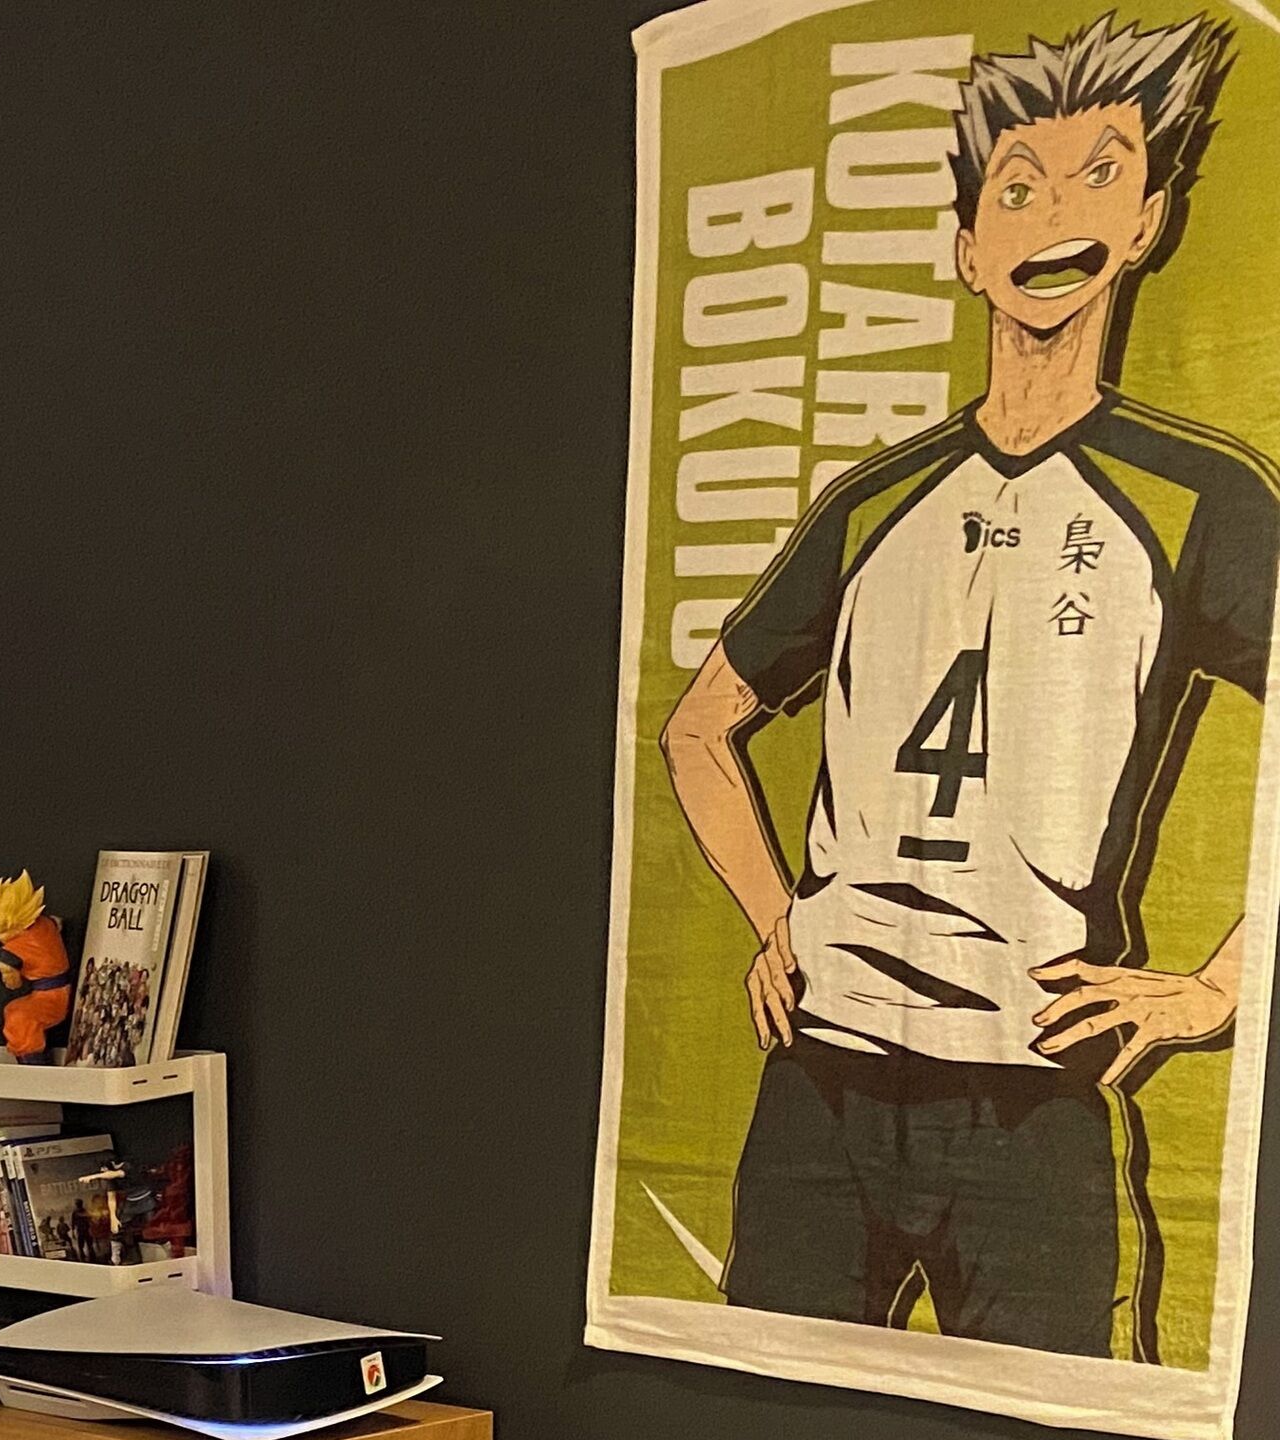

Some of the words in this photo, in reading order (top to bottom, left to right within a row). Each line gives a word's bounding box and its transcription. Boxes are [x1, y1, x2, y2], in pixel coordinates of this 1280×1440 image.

[810, 34, 974, 503] KOTAR
[1046, 512, 1105, 636] 梟谷
[894, 649, 988, 818] 4
[100, 881, 159, 905] DRAGON
[108, 907, 143, 931] BALL
[37, 1145, 63, 1155] PS5
